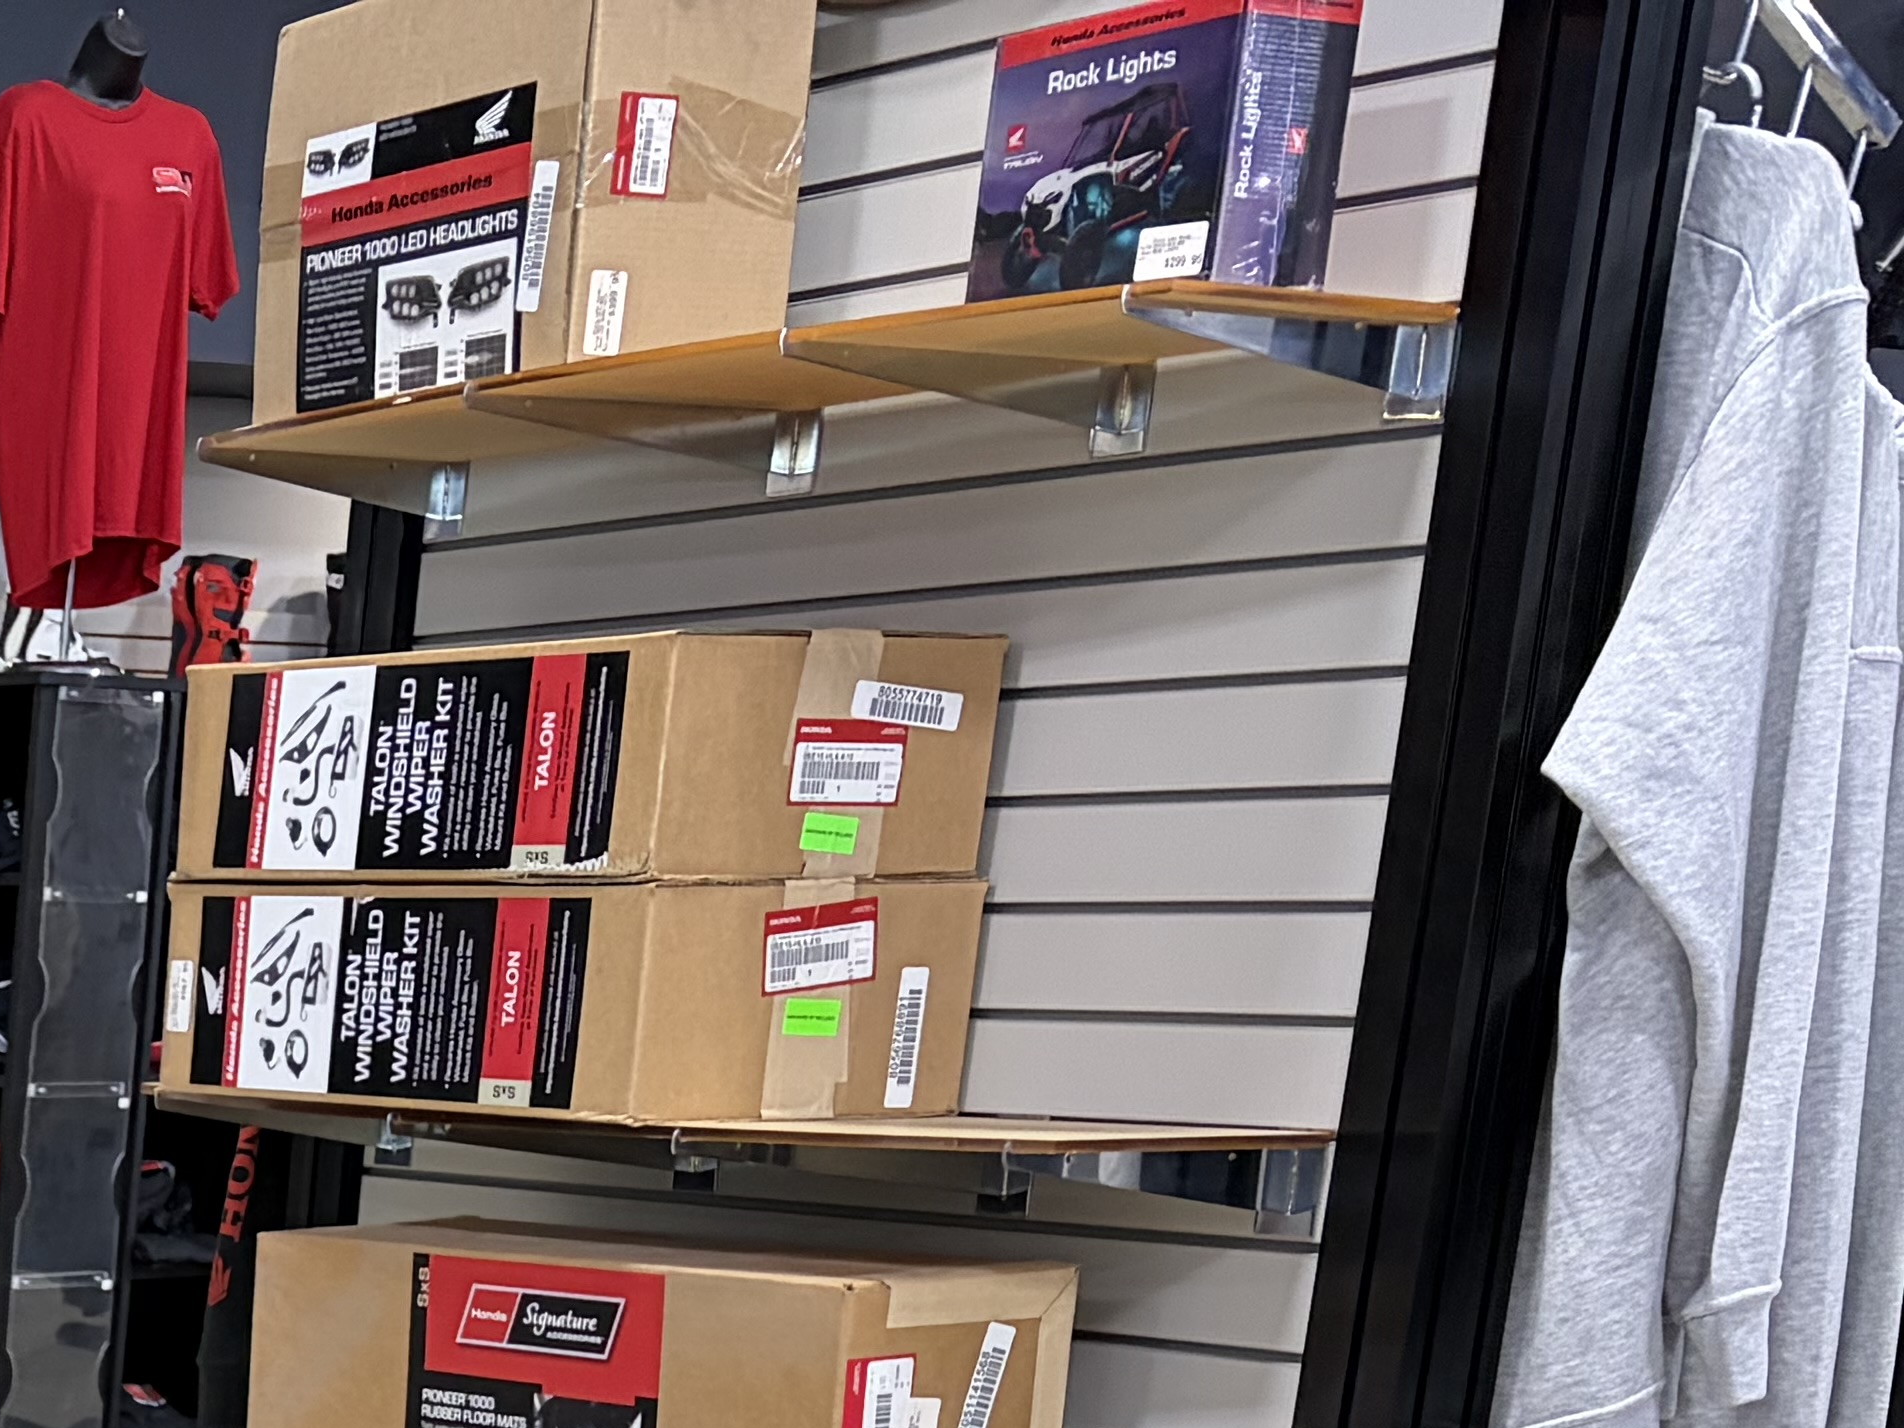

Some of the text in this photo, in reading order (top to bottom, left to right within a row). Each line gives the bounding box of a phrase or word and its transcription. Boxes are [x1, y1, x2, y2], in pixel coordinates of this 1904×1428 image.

[1047, 49, 1177, 95] Rock Lights
[331, 174, 492, 223] Honda Accessories
[307, 209, 518, 274] PIONEER 1000 LED HEADLIGHTS
[878, 685, 943, 706] 8055774719
[369, 723, 393, 816] TALON
[383, 677, 416, 857] WINDSHIELD
[406, 719, 430, 815] WIPER
[419, 676, 454, 856] WASHER KIT
[533, 710, 556, 791] TALON
[339, 953, 362, 1042] TALON
[352, 908, 386, 1082] WINDSHIELD
[375, 951, 400, 1042] WIPER
[389, 910, 421, 1083] WASHER KIT
[501, 950, 521, 1028] TALON
[417, 1267, 430, 1308] SxS
[471, 1302, 598, 1336] Honda Signature
[421, 1404, 462, 1422] RUBBER
[463, 1412, 495, 1426] FLOOR
[422, 1388, 495, 1409] PIONEER 1000
